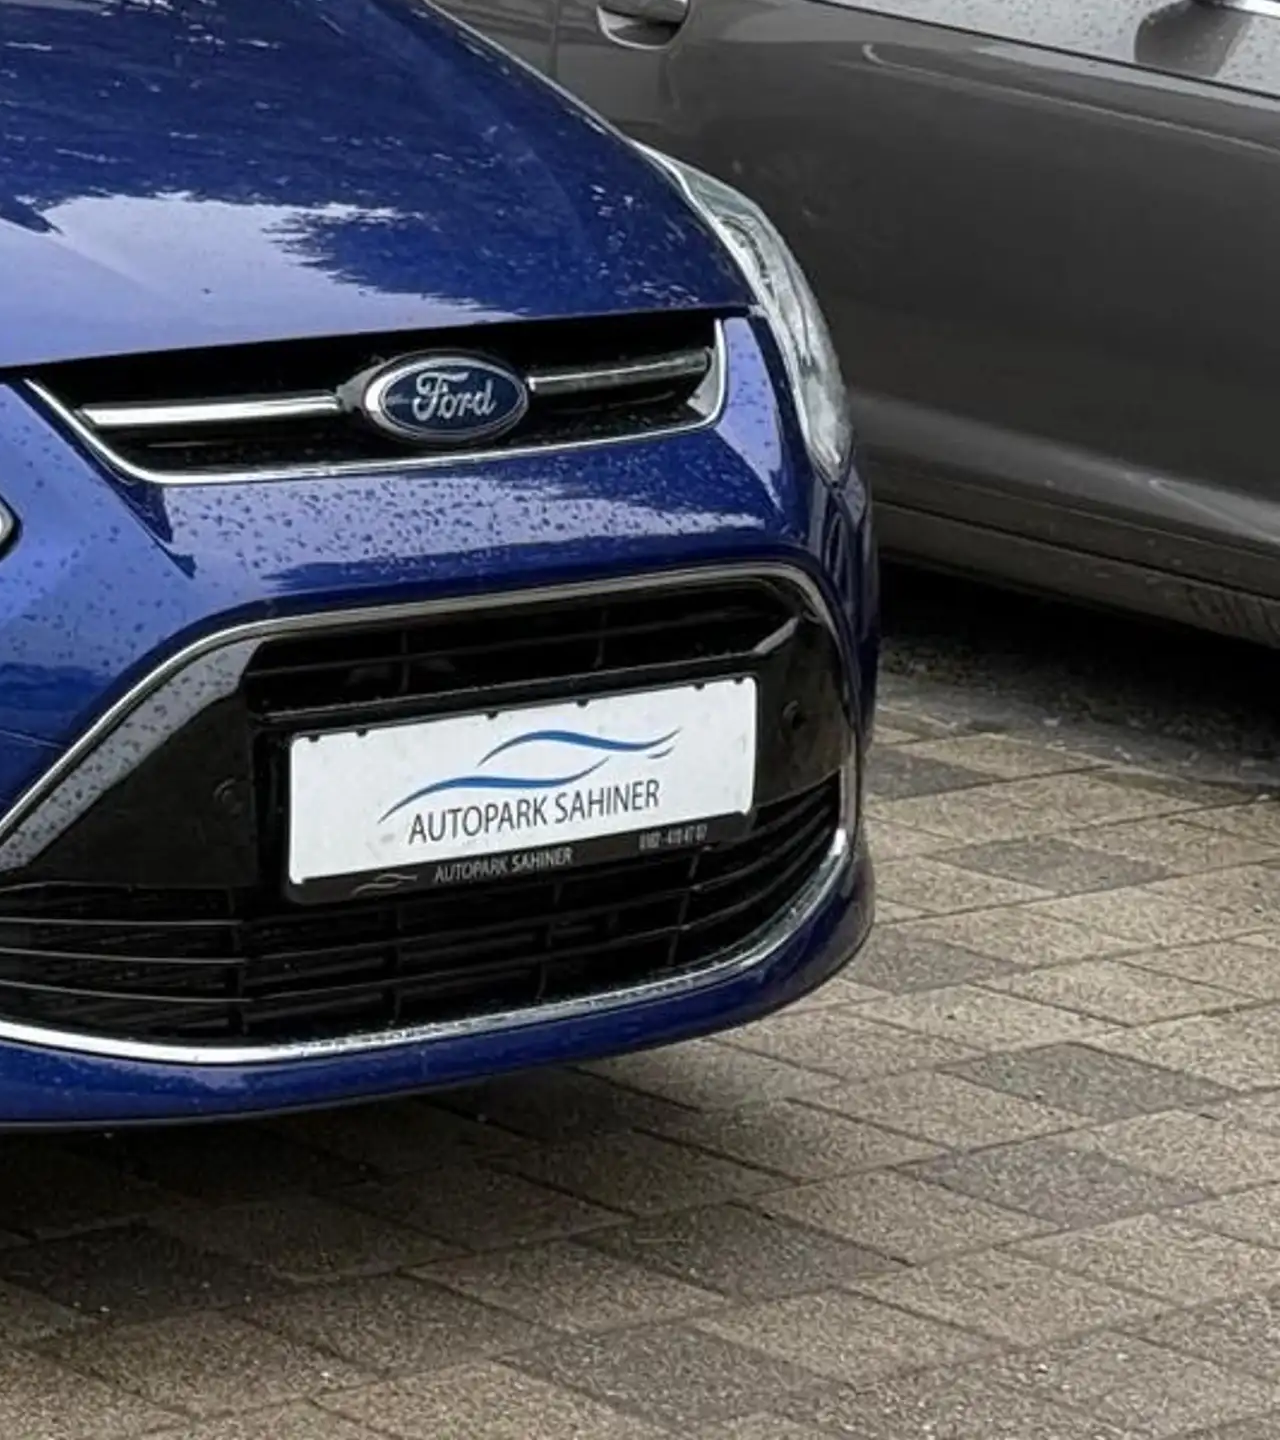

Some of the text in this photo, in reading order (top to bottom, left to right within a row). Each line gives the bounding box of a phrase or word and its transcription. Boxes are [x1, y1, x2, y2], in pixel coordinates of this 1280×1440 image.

[412, 370, 497, 422] Ford
[407, 778, 660, 845] AUTOPARK SAHINER
[434, 846, 574, 884] AUTOPARK SAHINER
